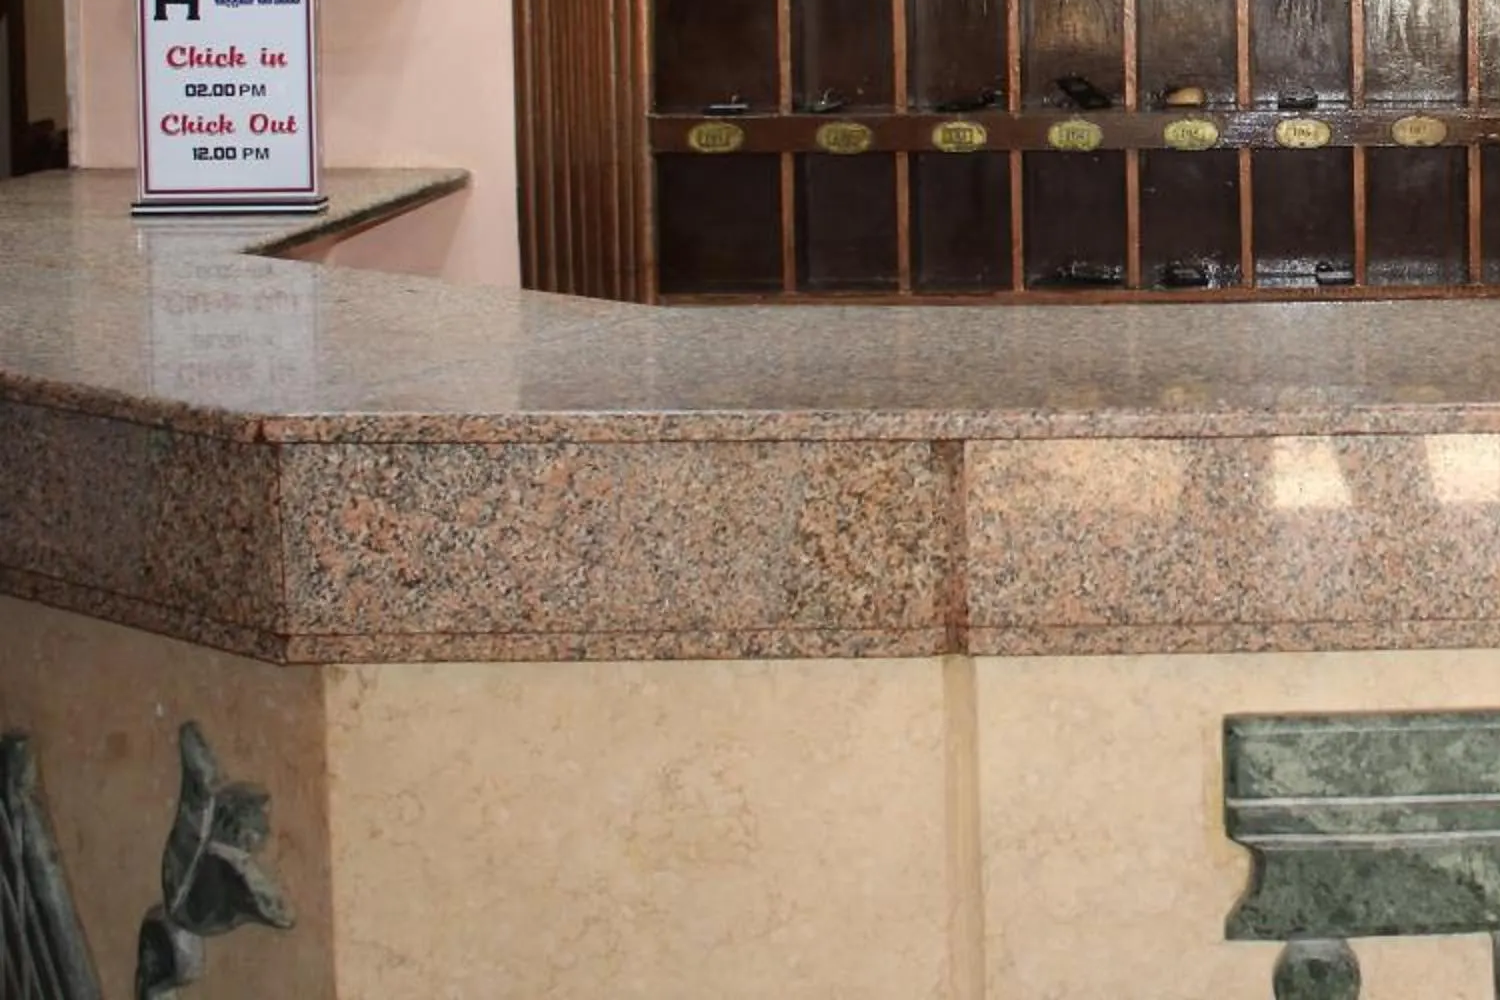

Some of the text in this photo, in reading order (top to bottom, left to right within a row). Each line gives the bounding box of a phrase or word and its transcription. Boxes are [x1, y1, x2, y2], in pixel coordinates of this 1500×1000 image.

[166, 45, 288, 68] Chick in
[185, 83, 266, 97] 02.00 PM
[160, 113, 298, 136] Chick Out
[192, 146, 269, 161] 12.00 PM
